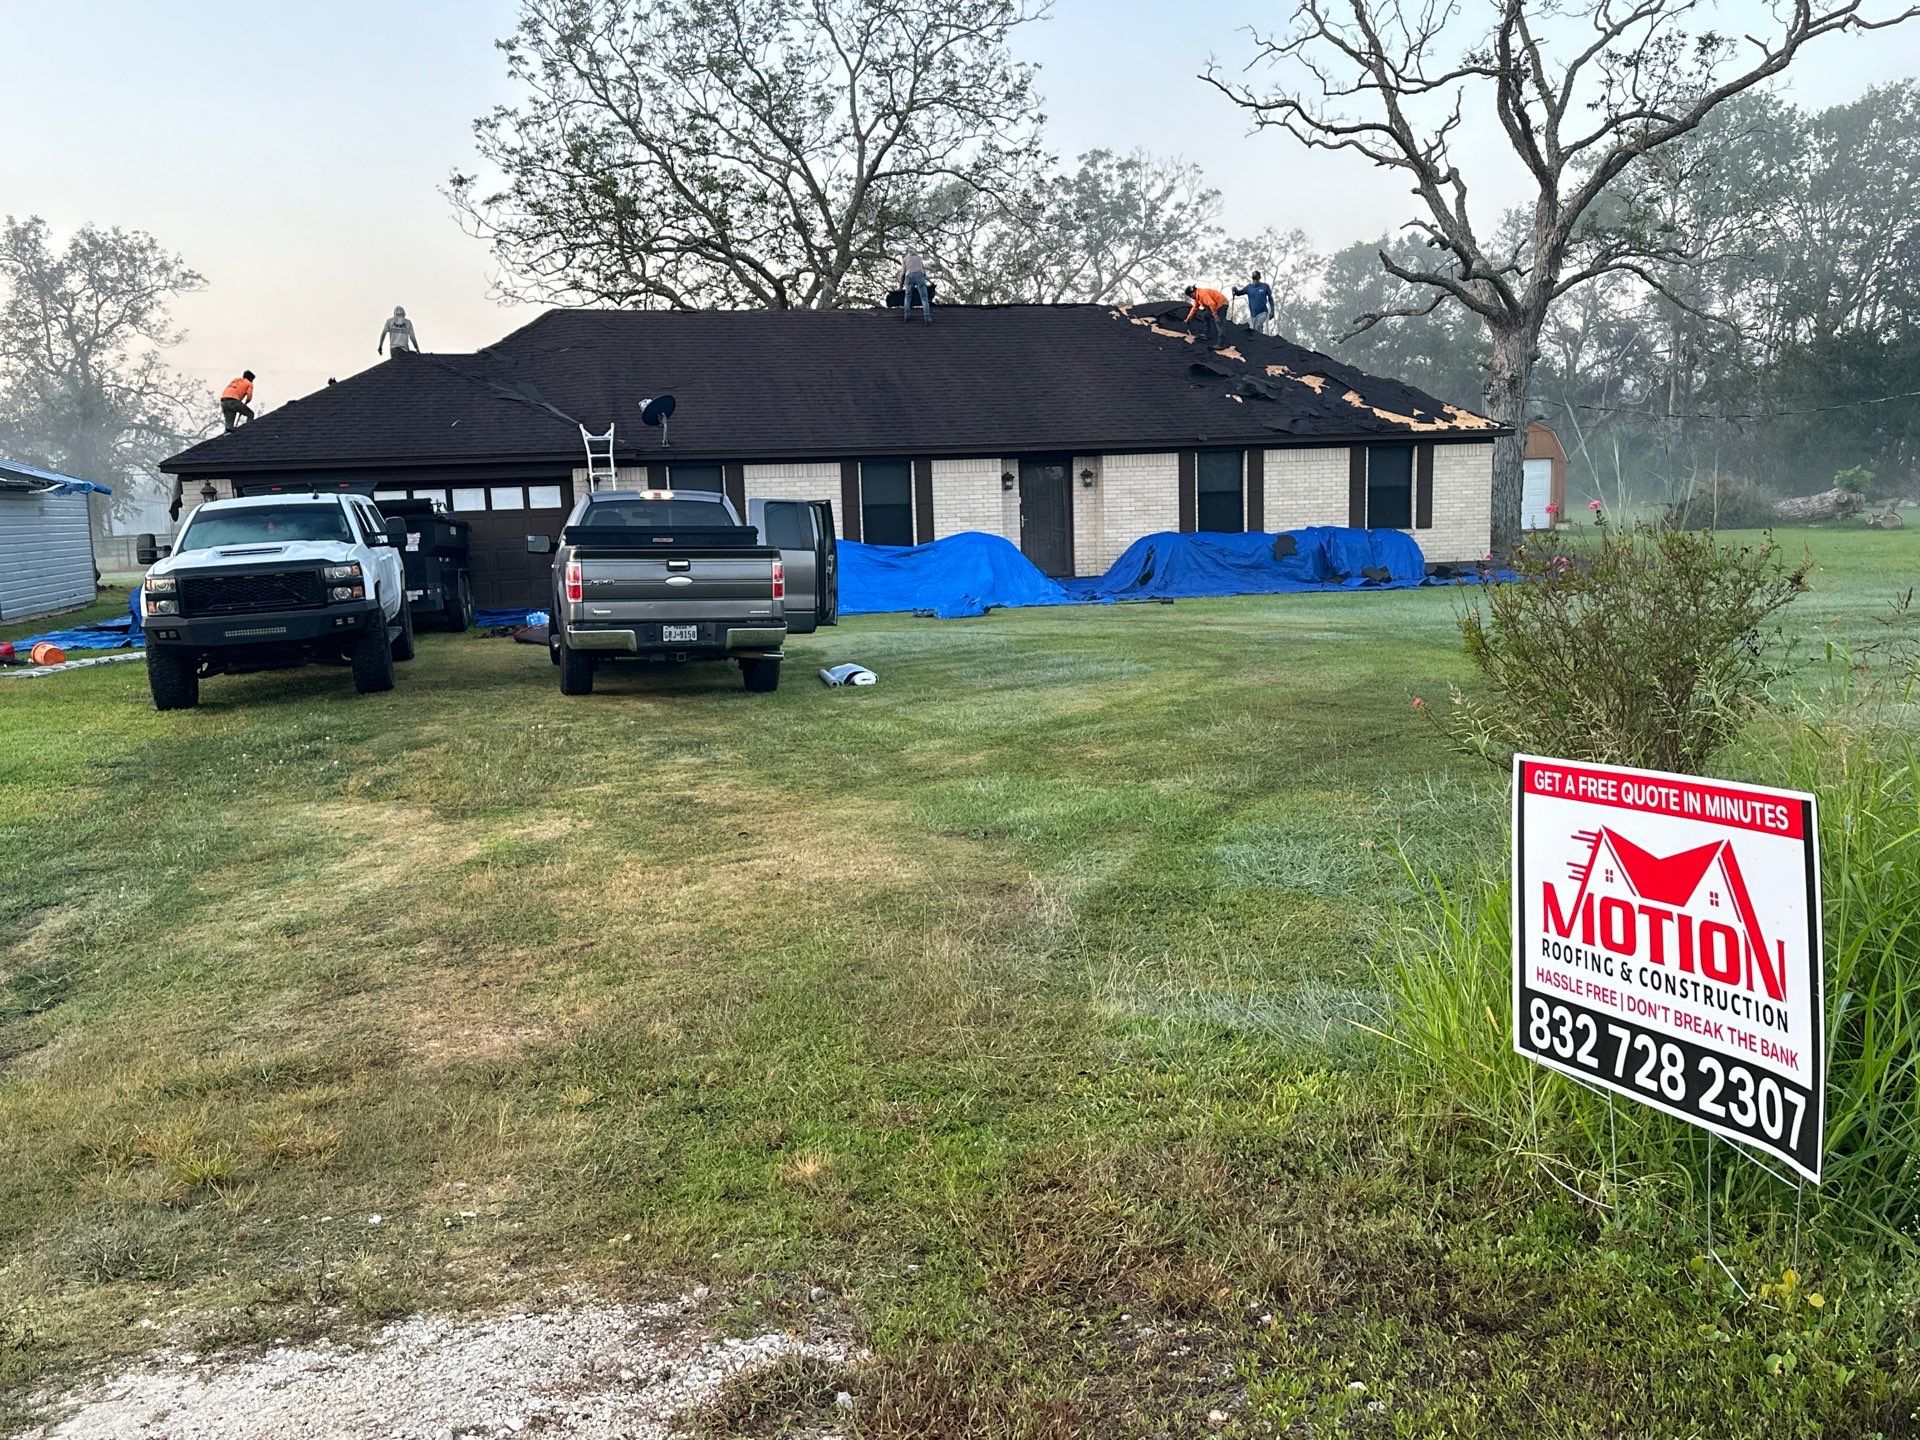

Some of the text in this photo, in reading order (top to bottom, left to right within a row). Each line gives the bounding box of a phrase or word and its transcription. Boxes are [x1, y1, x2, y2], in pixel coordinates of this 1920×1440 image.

[1533, 769, 1789, 830] GET A FREE QUOTE IN MINUTES
[1542, 866, 1787, 1003] MOTION
[1542, 937, 1788, 1033] ROOFING & CONSTRUCTION
[1536, 966, 1583, 995] HASSLE
[1586, 982, 1617, 1007] FREE
[1627, 995, 1670, 1023] DON'T
[1674, 1010, 1724, 1042] BREAK
[1727, 1026, 1757, 1053] THE
[1761, 1037, 1799, 1071] BANK
[1529, 997, 1807, 1151] 832 728 2307
